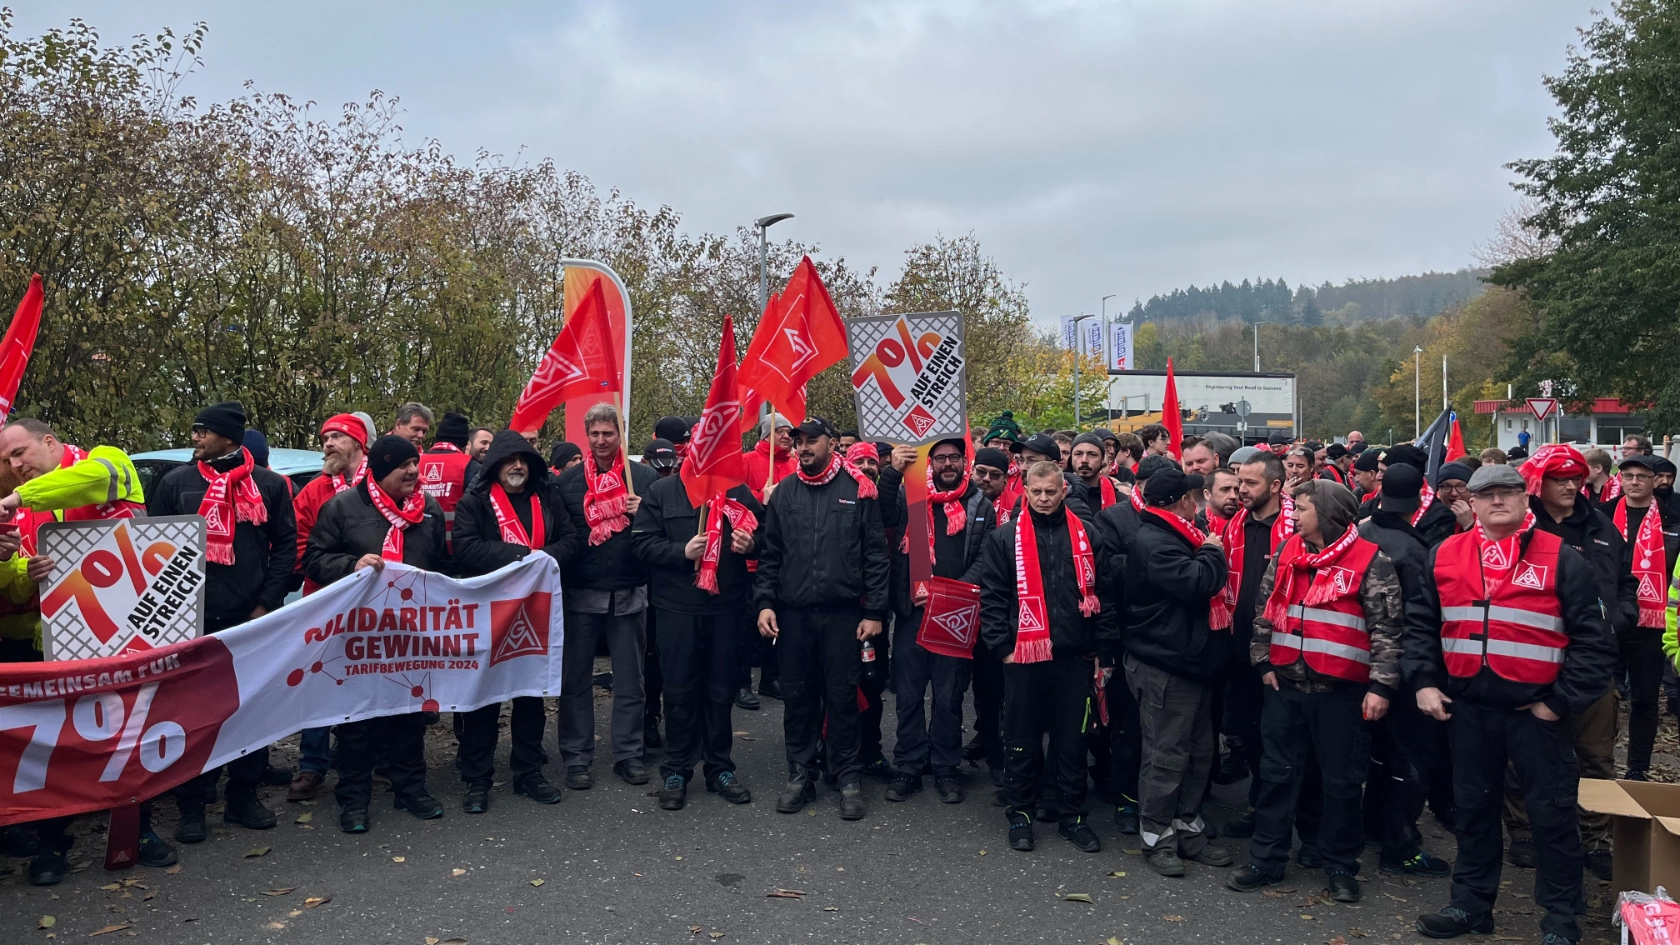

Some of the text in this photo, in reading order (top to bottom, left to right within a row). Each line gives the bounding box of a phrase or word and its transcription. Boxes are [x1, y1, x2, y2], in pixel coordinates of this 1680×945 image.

[851, 317, 943, 411] 7%
[910, 335, 958, 401] AUF EINEN
[921, 355, 963, 409] STREICH
[40, 523, 178, 646] 7%
[127, 545, 199, 629] AUF EINEN
[142, 569, 203, 640] STREICH
[344, 659, 479, 676] TARIFBEWEGUNG 2024
[345, 633, 480, 661] GEWINNT
[0, 682, 186, 794] 7%
